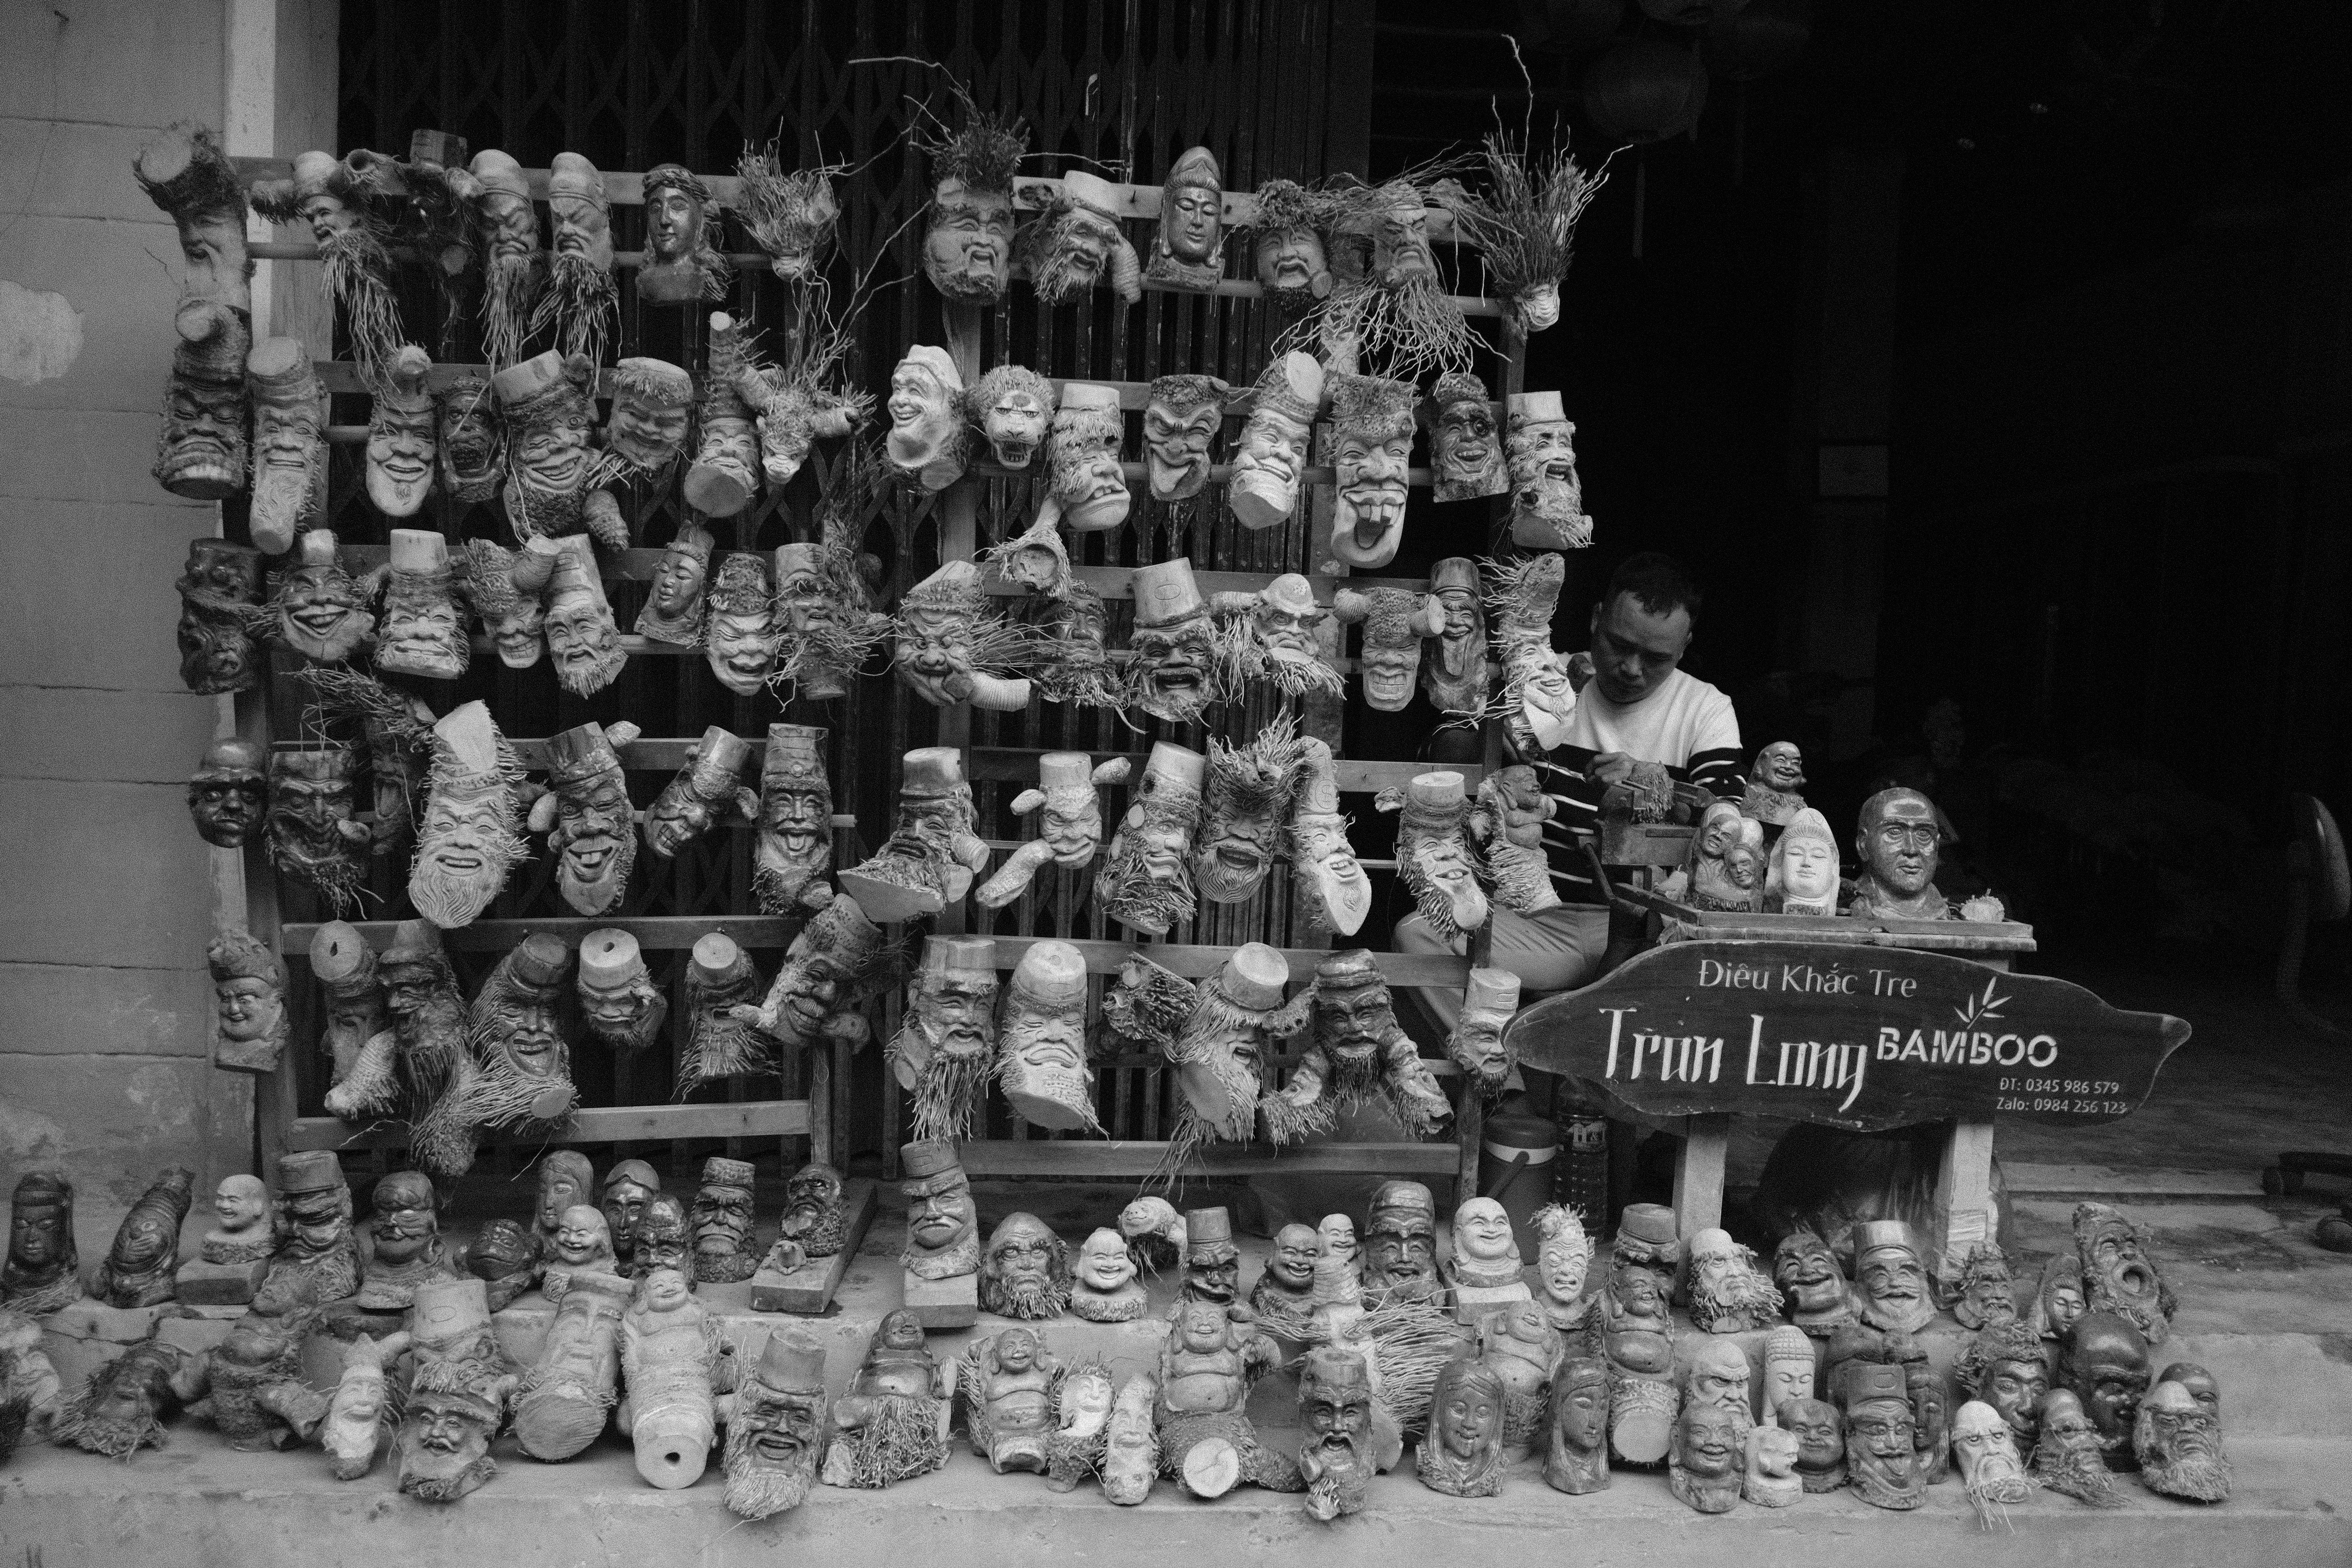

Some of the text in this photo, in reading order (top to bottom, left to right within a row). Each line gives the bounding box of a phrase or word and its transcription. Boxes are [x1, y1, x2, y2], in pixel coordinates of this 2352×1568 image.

[1698, 960, 1917, 997] Điêu Khắc Tre
[1746, 1014, 1868, 1112] Long
[1877, 1027, 2058, 1067] BAMBOO
[2000, 1078, 2120, 1094] ĐT: 0345 986 579
[1996, 1097, 2128, 1114] Zalo: 0984 256 123
